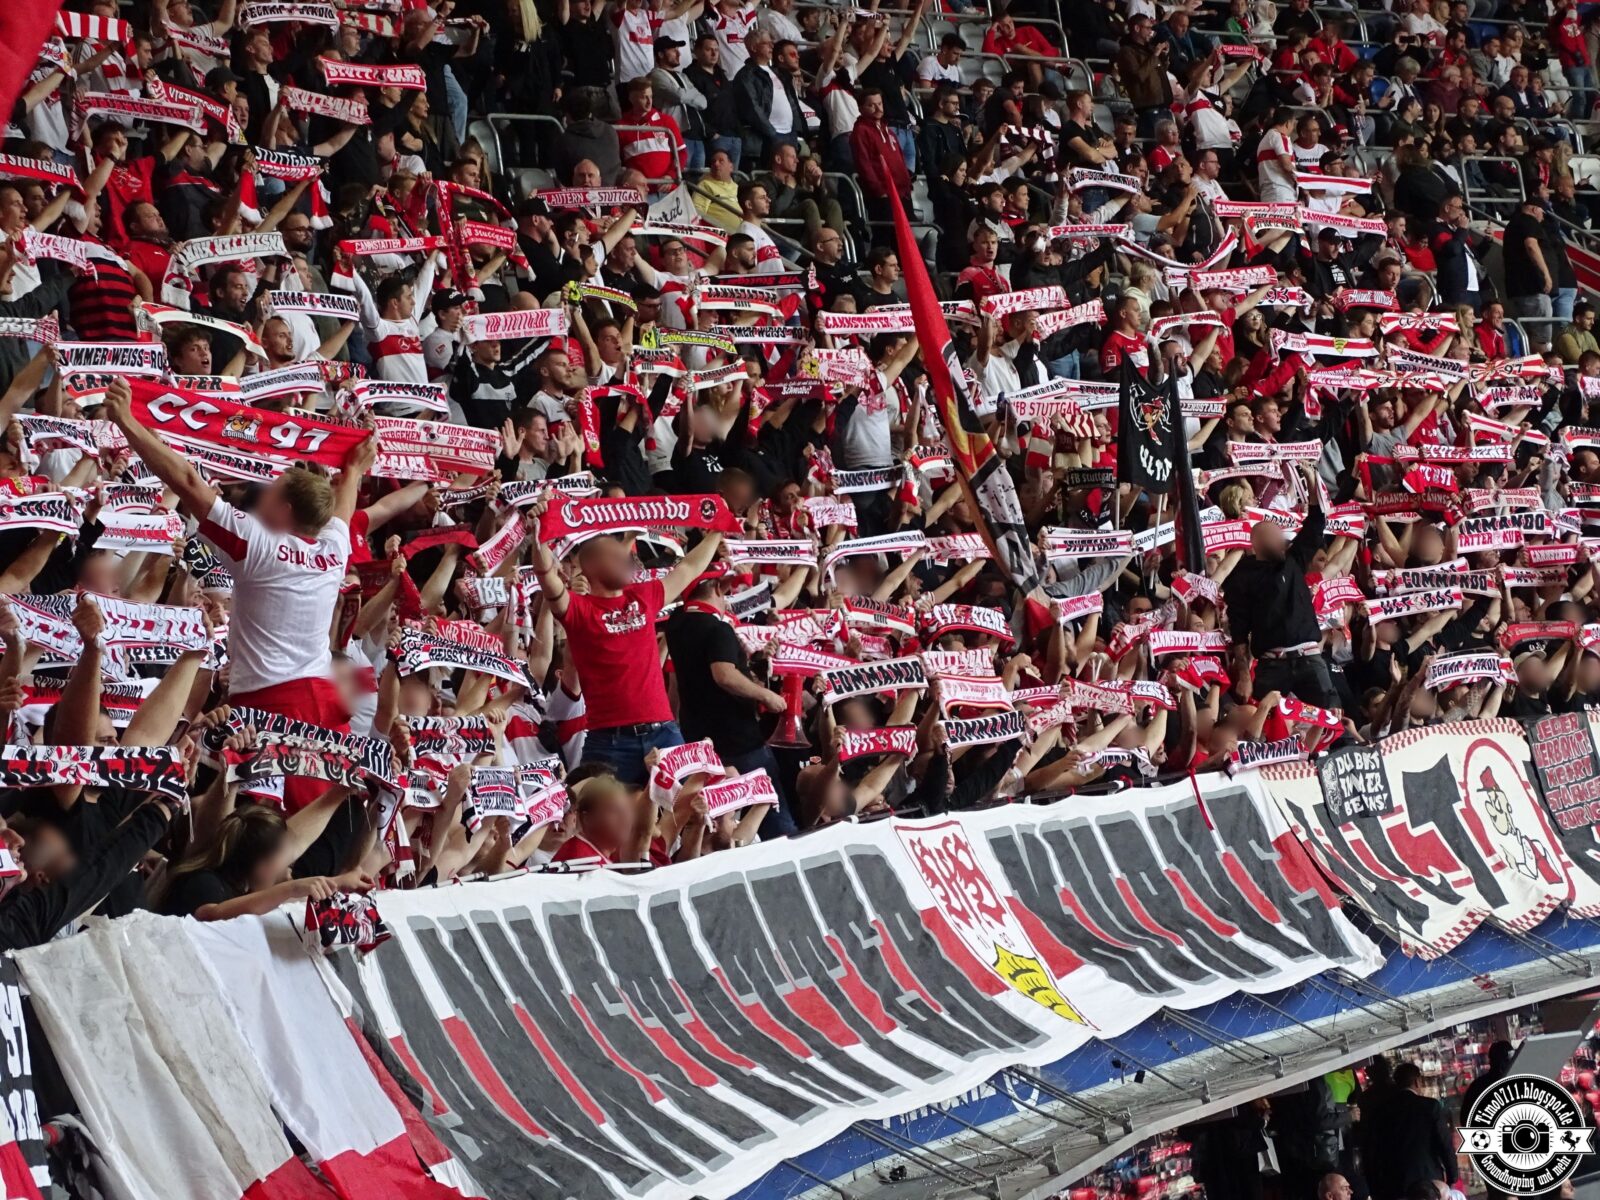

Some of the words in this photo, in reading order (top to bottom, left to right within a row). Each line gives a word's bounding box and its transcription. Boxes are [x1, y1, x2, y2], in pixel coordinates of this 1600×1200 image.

[824, 316, 892, 330] CANNSTATTER
[70, 346, 109, 366] IMMER
[112, 346, 143, 366] WEISS
[1503, 363, 1523, 374] 97
[147, 392, 221, 430] CC
[269, 420, 333, 453] 97
[560, 497, 691, 528] Commando
[1459, 513, 1546, 535] MMANDO
[1402, 570, 1489, 591] COMMANDO
[827, 660, 924, 695] COMMANDO
[1431, 659, 1461, 679] ECKAR
[945, 711, 1025, 744] COMMANDO
[1535, 713, 1580, 742] JEDER
[1238, 735, 1299, 763] COMMANDO
